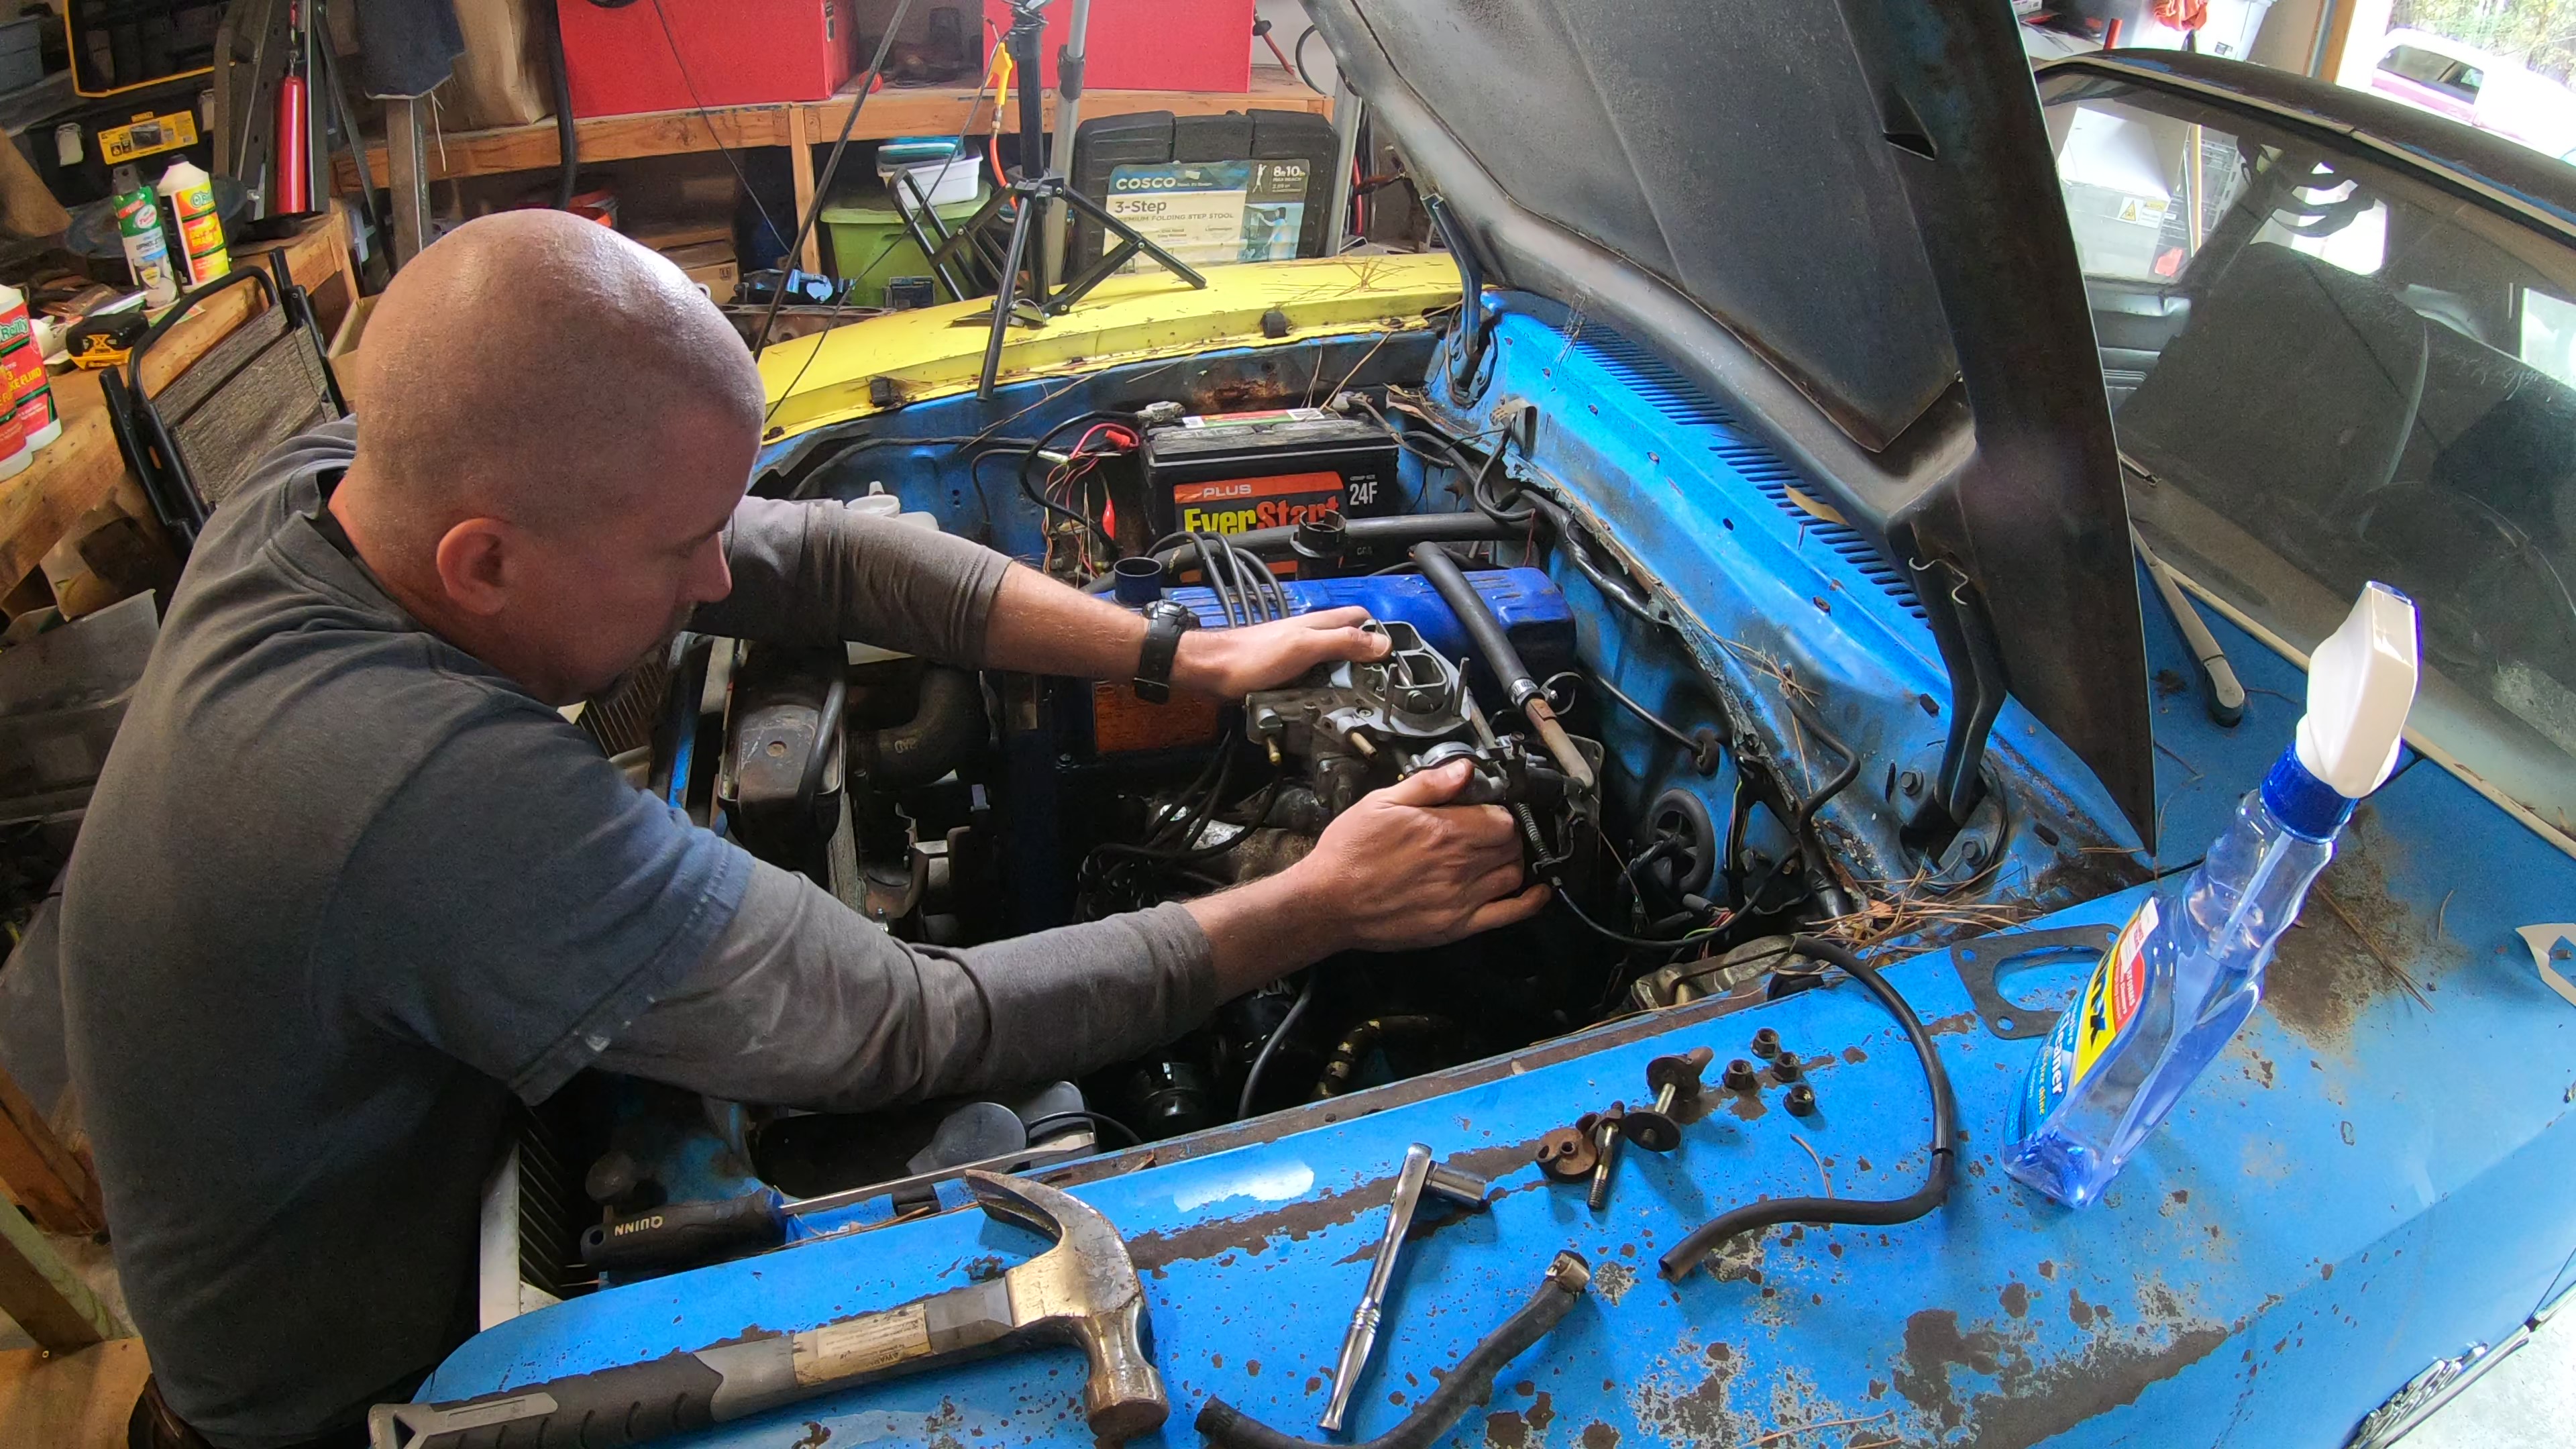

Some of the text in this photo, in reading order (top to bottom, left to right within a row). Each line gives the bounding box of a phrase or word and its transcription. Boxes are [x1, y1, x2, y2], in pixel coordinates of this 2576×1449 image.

[1116, 177, 1176, 191] COSCO
[1114, 201, 1167, 214] 3-Step
[1, 319, 28, 340] Reilly
[1203, 484, 1252, 498] PLUS
[1350, 481, 1378, 506] 24F
[2051, 1011, 2072, 1095] Cleaner
[614, 1216, 663, 1236] QUINN
